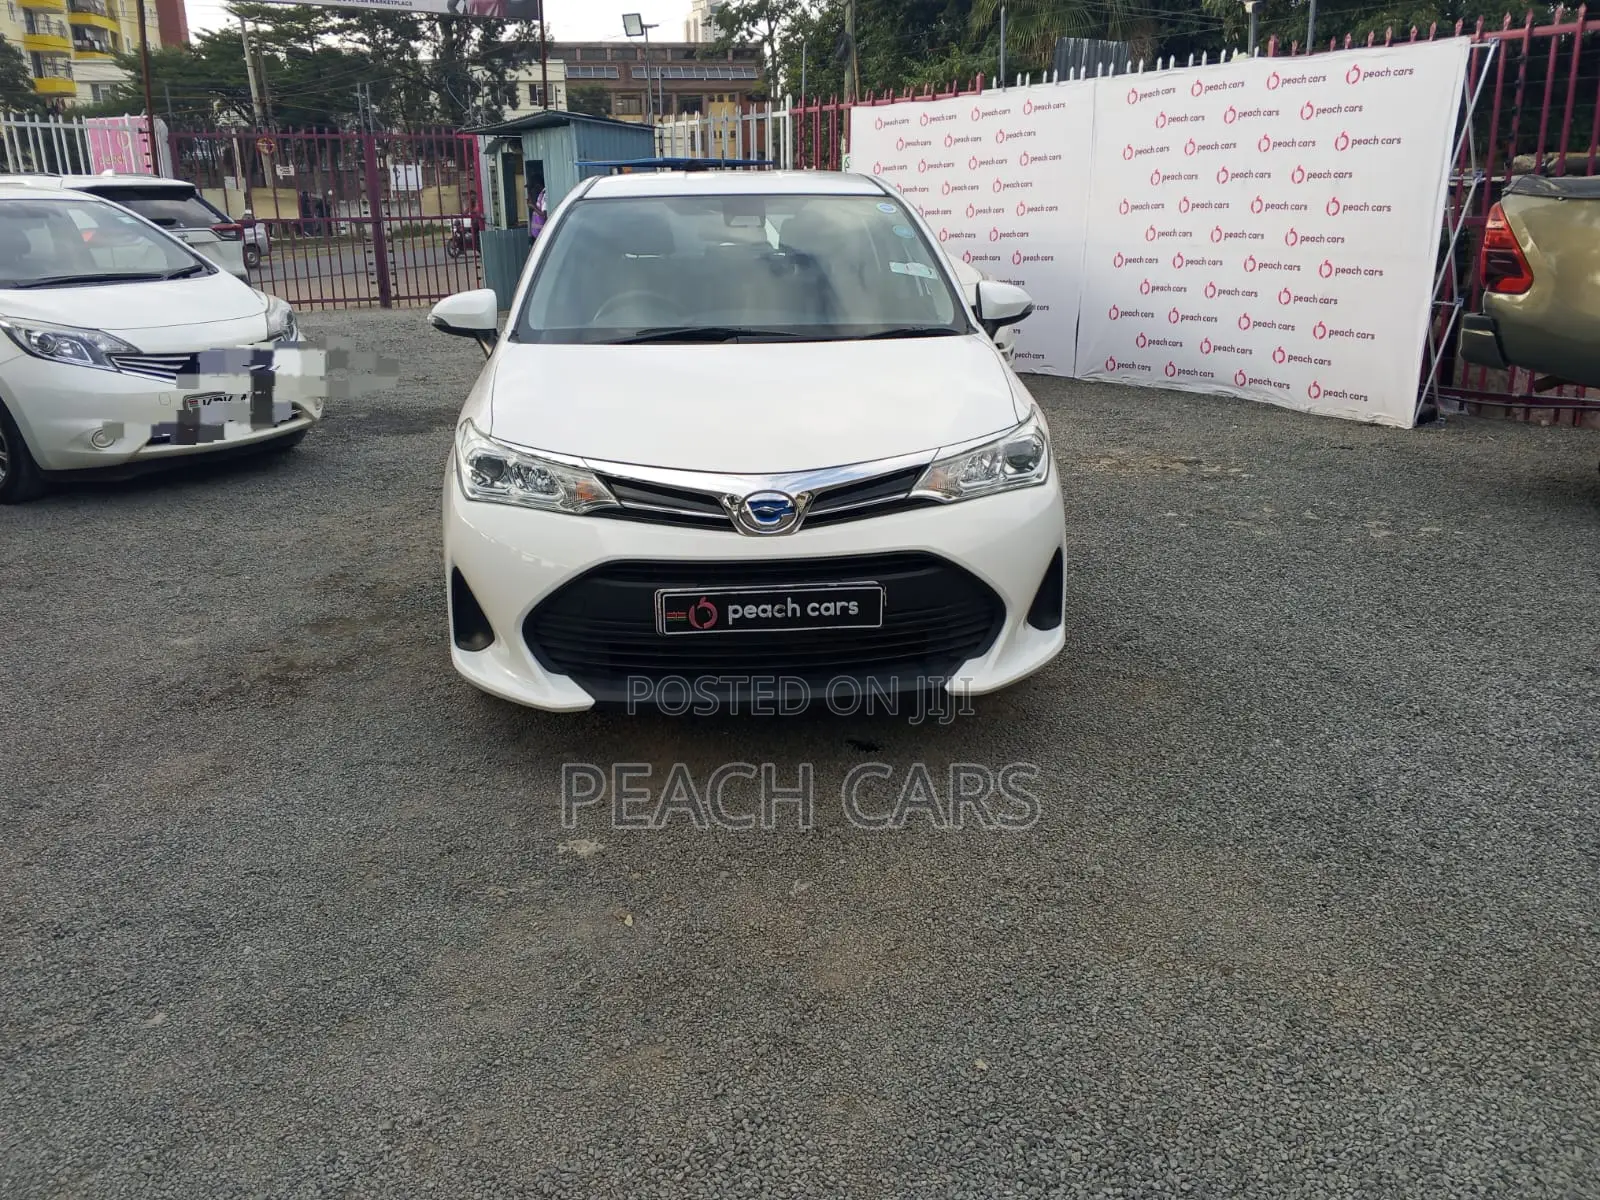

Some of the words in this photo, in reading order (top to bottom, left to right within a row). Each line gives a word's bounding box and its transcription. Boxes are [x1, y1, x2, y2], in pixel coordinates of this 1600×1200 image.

[1362, 66, 1391, 82] peach
[1392, 68, 1414, 76] cars
[1281, 74, 1307, 88] peach
[1307, 75, 1327, 83] cars
[1203, 80, 1227, 95] peach
[1228, 81, 1245, 89] cars
[1139, 88, 1160, 102] peach
[1160, 87, 1176, 95] cars
[1033, 101, 1052, 113] peach
[1315, 103, 1342, 118] peach
[1343, 105, 1363, 113] cars
[929, 113, 945, 124] peach
[981, 108, 999, 120] peach
[998, 108, 1011, 116] cars
[1167, 113, 1189, 126] peach
[1237, 107, 1261, 121] peach
[883, 118, 899, 128] peach
[953, 135, 970, 146] peach
[1005, 129, 1023, 141] peach
[904, 139, 920, 149] peach
[1196, 141, 1219, 154] peach
[1220, 142, 1237, 150] cars
[1271, 137, 1296, 151] peach
[1297, 140, 1316, 148] cars
[1350, 135, 1379, 149] peach
[1380, 137, 1401, 145] cars
[1134, 145, 1155, 158] peach
[1155, 145, 1170, 153] cars
[978, 157, 995, 168] peach
[1030, 153, 1048, 164] peach
[882, 164, 896, 173] peach
[926, 161, 943, 171] peach
[1161, 171, 1182, 184] peach
[1230, 169, 1253, 182] peach
[1306, 169, 1332, 182] peach
[1333, 171, 1352, 179] cars
[902, 185, 918, 195] peach
[951, 183, 967, 193] peach
[1002, 180, 1020, 191] peach
[975, 206, 992, 216] peach
[1026, 204, 1044, 214] peach
[1130, 201, 1150, 213] peach
[1191, 200, 1213, 212] peach
[1264, 200, 1289, 212] peach
[1290, 203, 1308, 211] cars
[1342, 202, 1369, 215] peach
[1371, 204, 1391, 212] cars
[924, 208, 940, 218] peach
[948, 231, 964, 240] peach
[999, 230, 1016, 240] peach
[1157, 228, 1177, 240] peach
[1223, 229, 1247, 241] peach
[1247, 232, 1264, 240] cars
[1299, 233, 1325, 245] peach
[1326, 236, 1345, 244] cars
[971, 253, 988, 264] peach
[1022, 253, 1040, 264] peach
[1124, 255, 1144, 266] peach
[1185, 256, 1207, 267] peach
[1258, 260, 1282, 271] peach
[1283, 263, 1301, 272] cars
[1334, 265, 1362, 277] peach
[1150, 283, 1171, 294] peach
[1217, 287, 1240, 297] peach
[1240, 290, 1258, 298] cars
[1293, 294, 1318, 304] peach
[1318, 297, 1338, 305] cars
[1119, 308, 1140, 319] peach
[1180, 312, 1202, 323] peach
[1202, 315, 1218, 323] cars
[1252, 319, 1276, 329] peach
[1277, 323, 1295, 331] cars
[1328, 328, 1354, 339] peach
[1355, 332, 1375, 340] cars
[1147, 337, 1167, 347] peach
[1168, 340, 1183, 348] cars
[1212, 344, 1235, 353] peach
[1236, 347, 1253, 355] cars
[1014, 351, 1032, 361] peach
[1287, 354, 1312, 364] peach
[1313, 358, 1331, 366] cars
[1116, 361, 1136, 370] peach
[1137, 364, 1151, 372] cars
[1177, 367, 1198, 377] peach
[1198, 370, 1214, 378] cars
[1248, 377, 1272, 387] peach
[1273, 381, 1290, 390] cars
[1322, 389, 1348, 399] peach
[1349, 393, 1368, 402] cars
[728, 597, 800, 625] peach
[807, 600, 859, 616] cars
